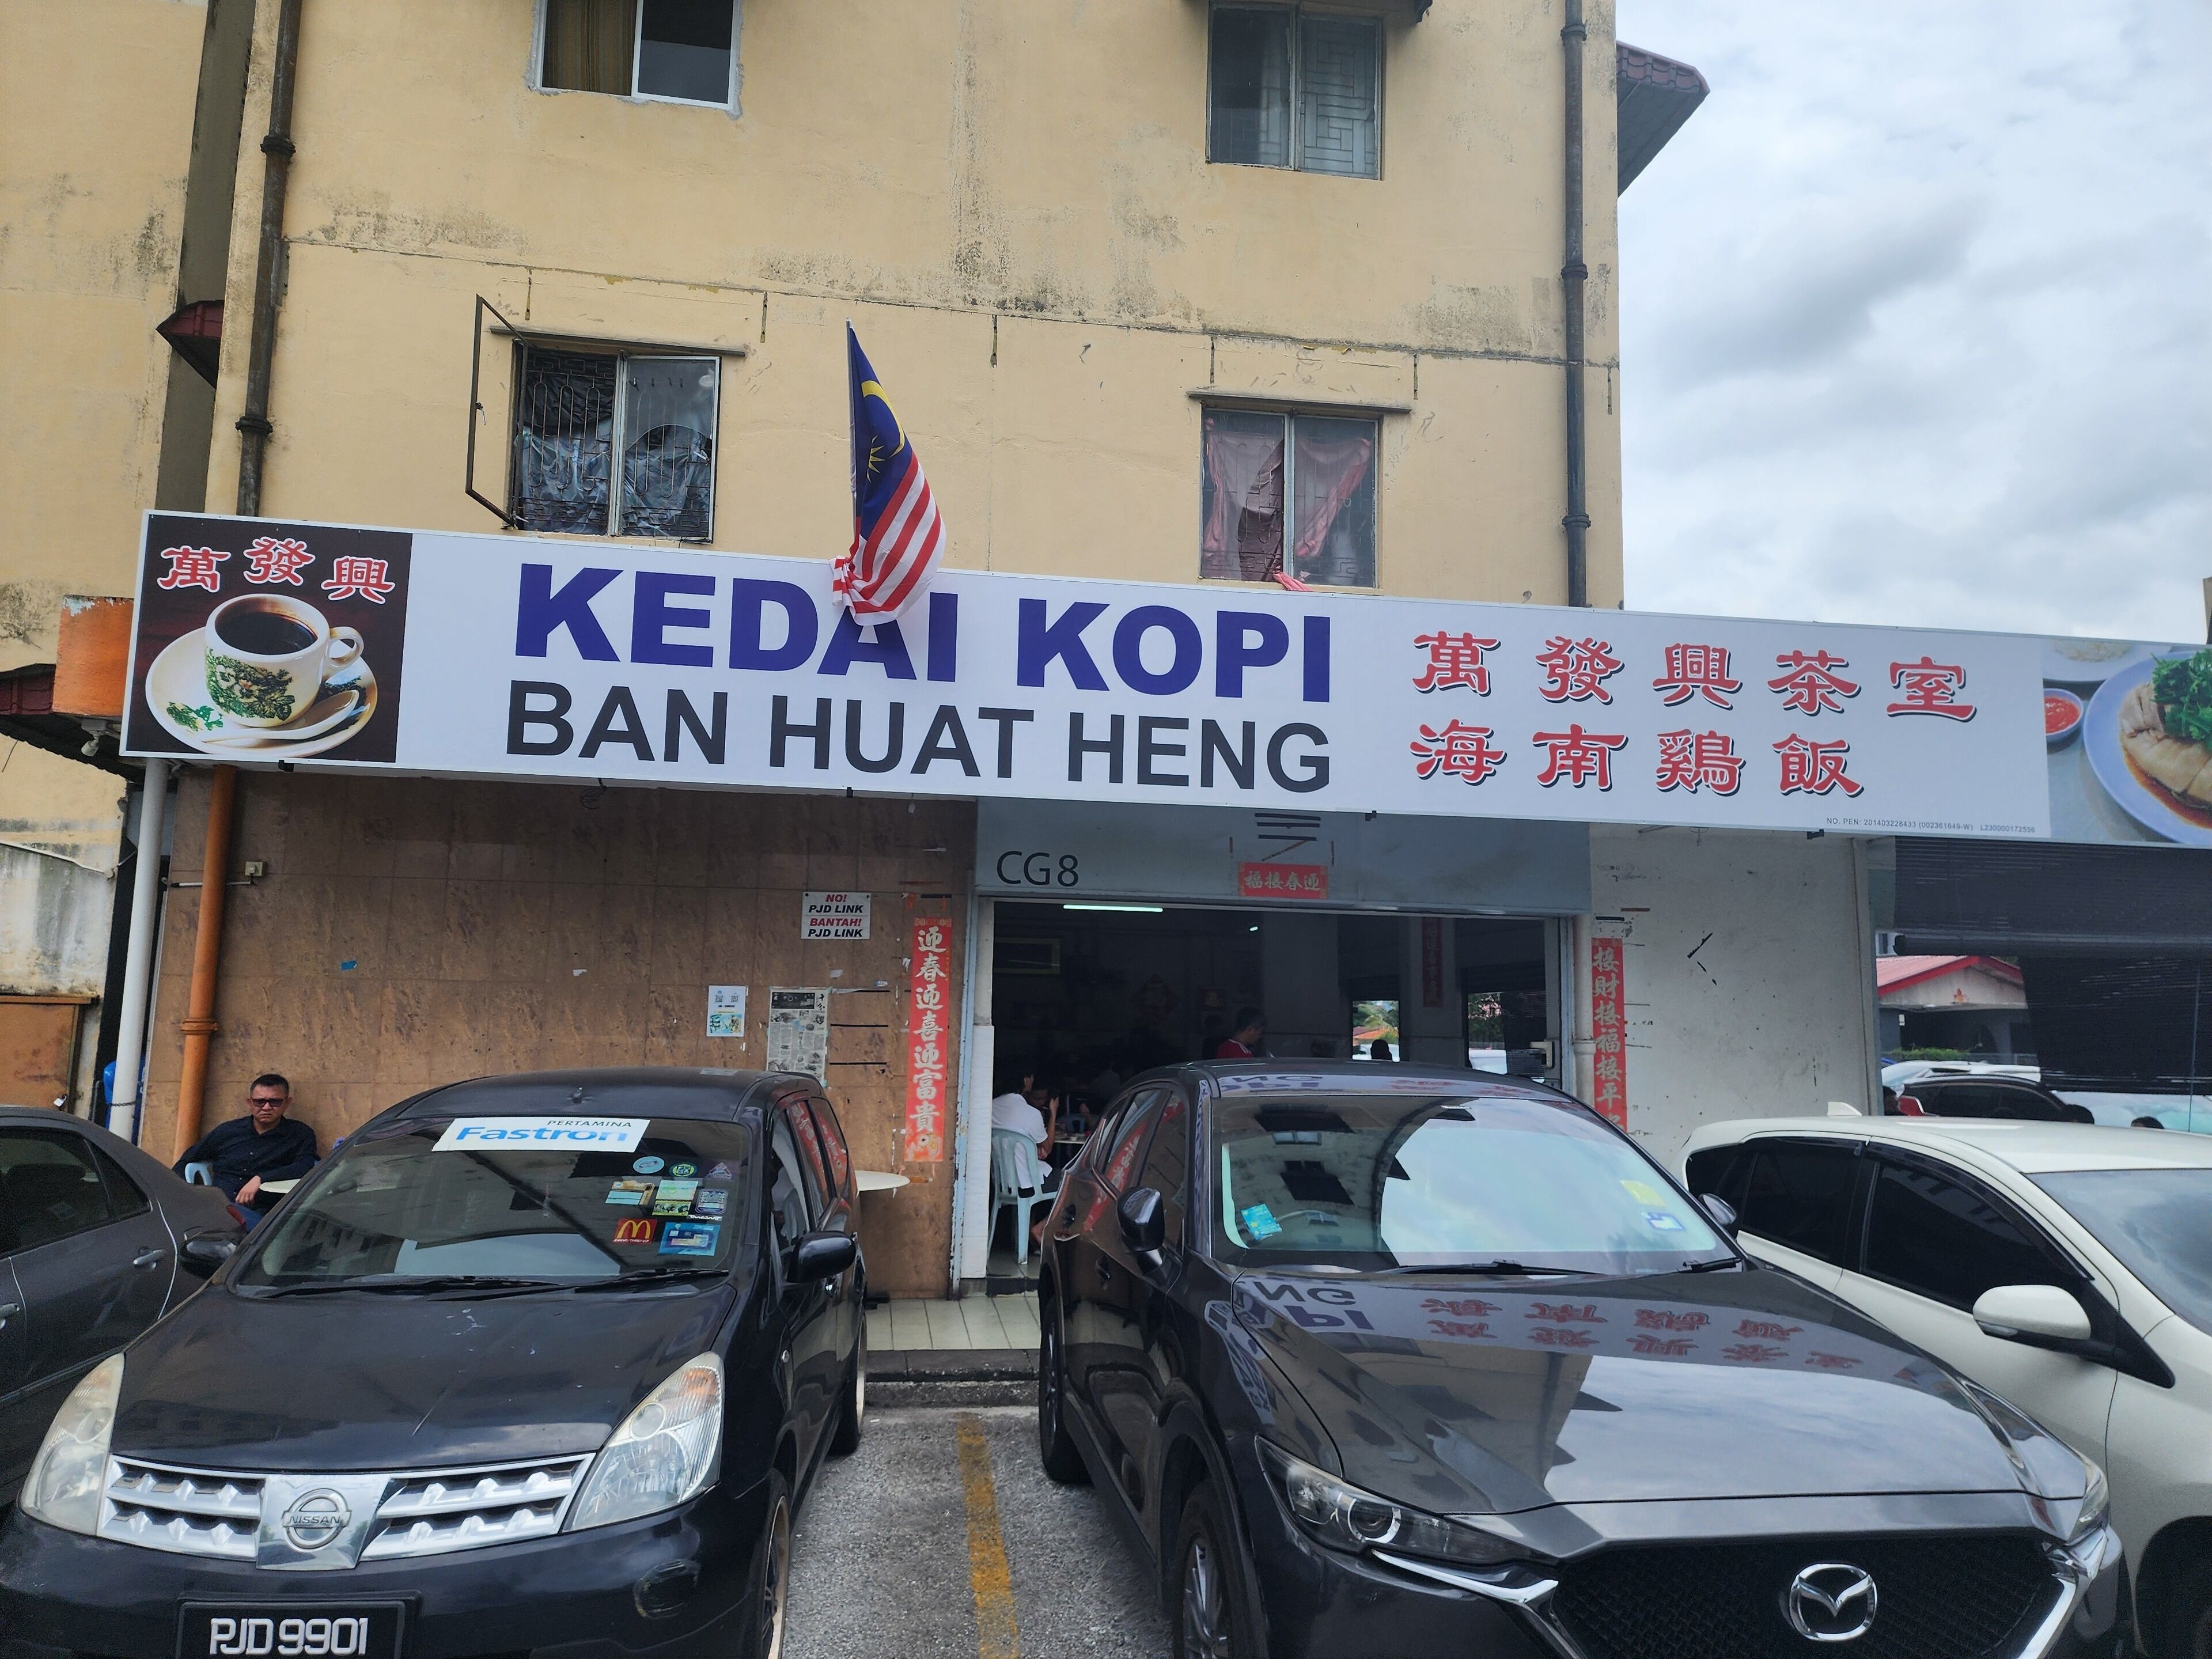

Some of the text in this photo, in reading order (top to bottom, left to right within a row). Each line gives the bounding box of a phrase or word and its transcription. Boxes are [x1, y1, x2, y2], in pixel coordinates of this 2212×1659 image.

[157, 536, 396, 604] 萬發興
[516, 563, 1331, 702] KEDAI KOPI
[1412, 631, 1976, 722] 萬發興茶室
[506, 680, 1330, 793] BAN HUAT HENG
[996, 850, 1079, 887] CG8
[808, 904, 863, 914] PJD LINK
[825, 894, 847, 903] NO!
[808, 929, 863, 937] PJD LINK
[809, 918, 862, 926] BANTAH!
[910, 926, 947, 1132] 迎春迎喜迎富貴
[455, 1127, 628, 1142] Fastron
[547, 1119, 632, 1128] PERTAMINA
[289, 1514, 342, 1526] NISSAN
[209, 1618, 369, 1655] PJD 9901
